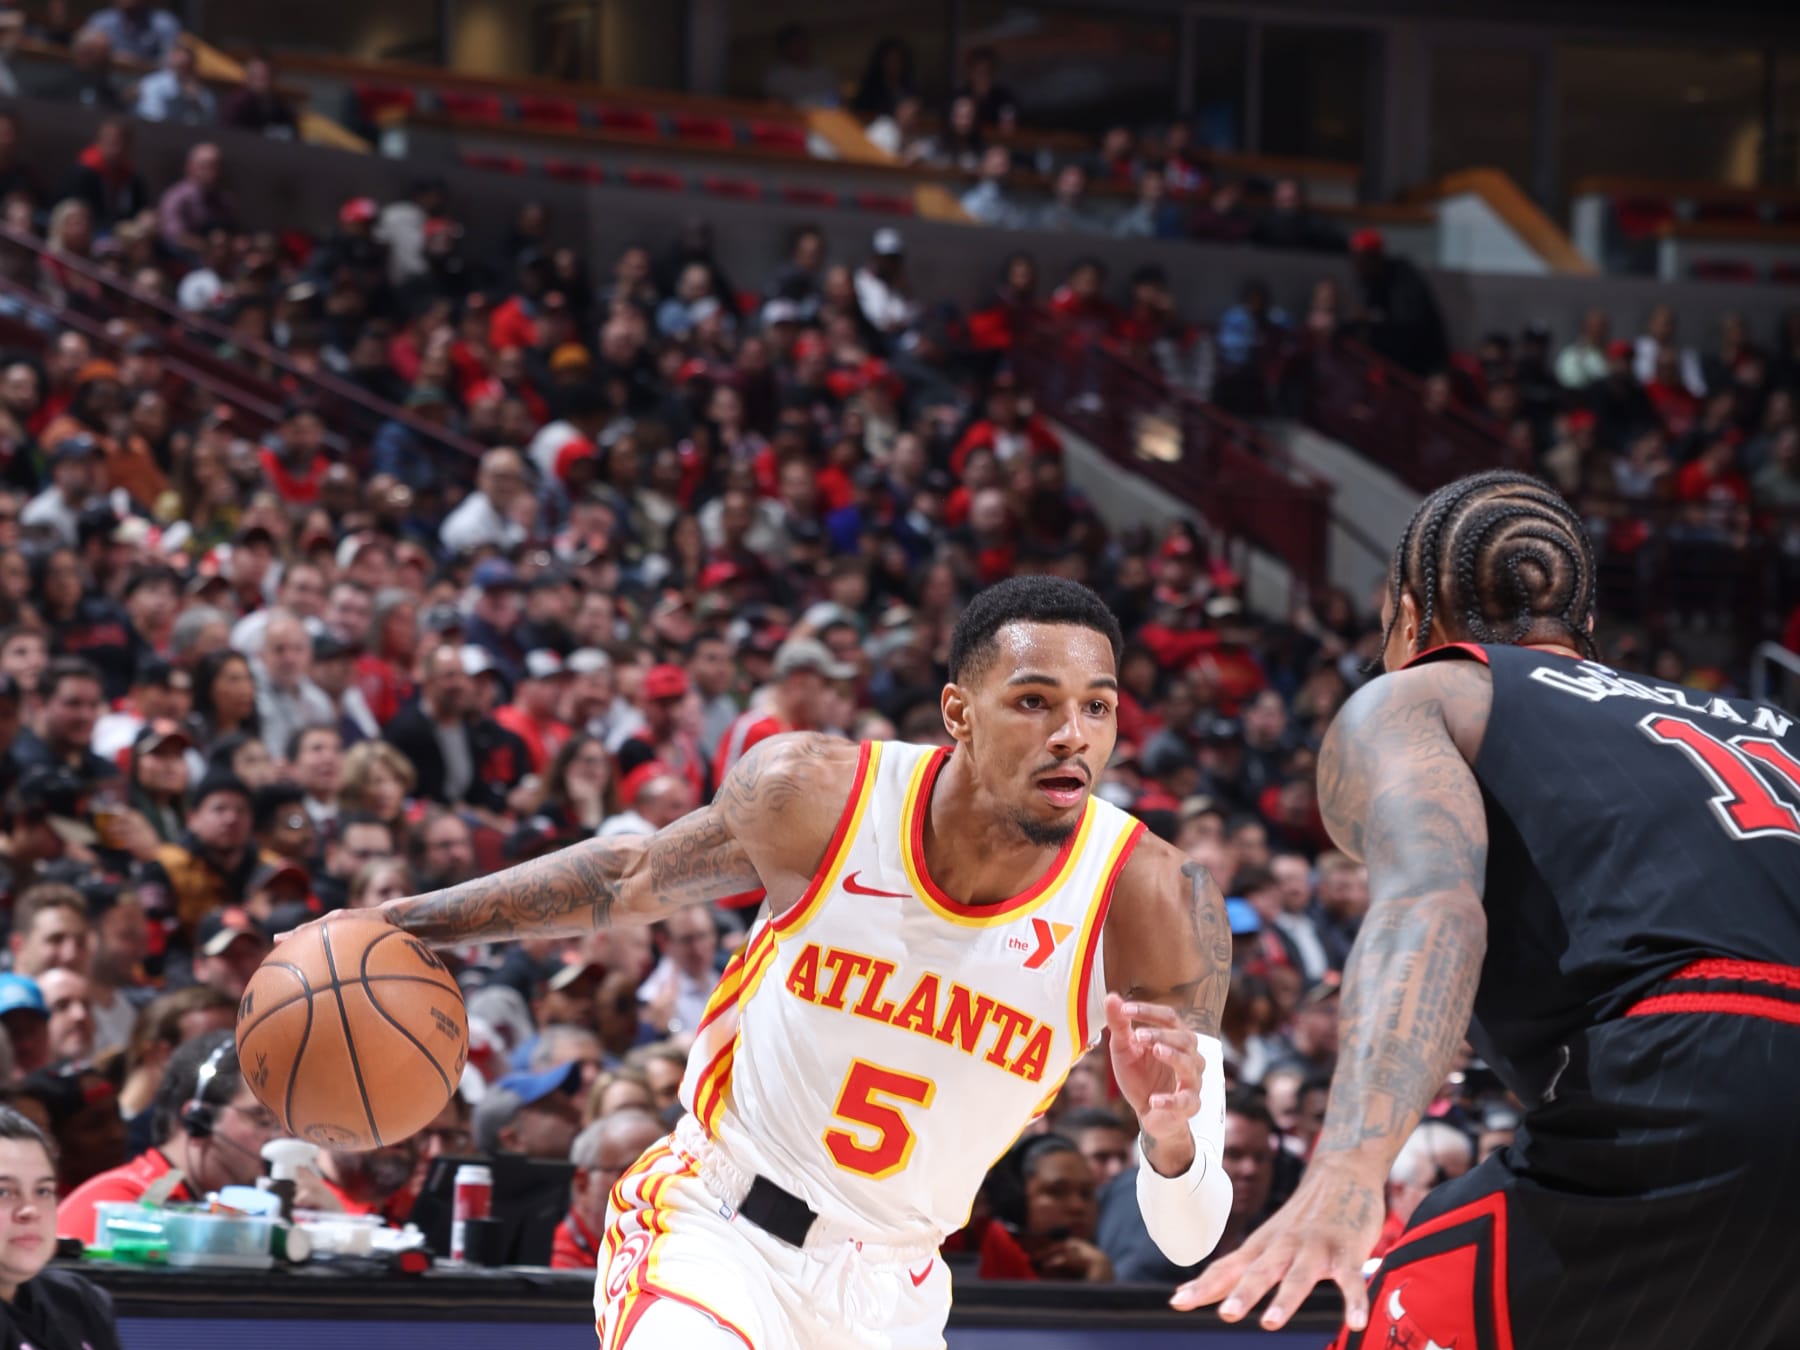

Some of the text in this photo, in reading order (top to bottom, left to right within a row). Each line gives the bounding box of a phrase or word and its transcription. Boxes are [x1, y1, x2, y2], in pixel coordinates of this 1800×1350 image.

[1008, 937, 1029, 952] the
[785, 940, 1055, 1084] ATLANTA
[821, 1057, 938, 1182] 5
